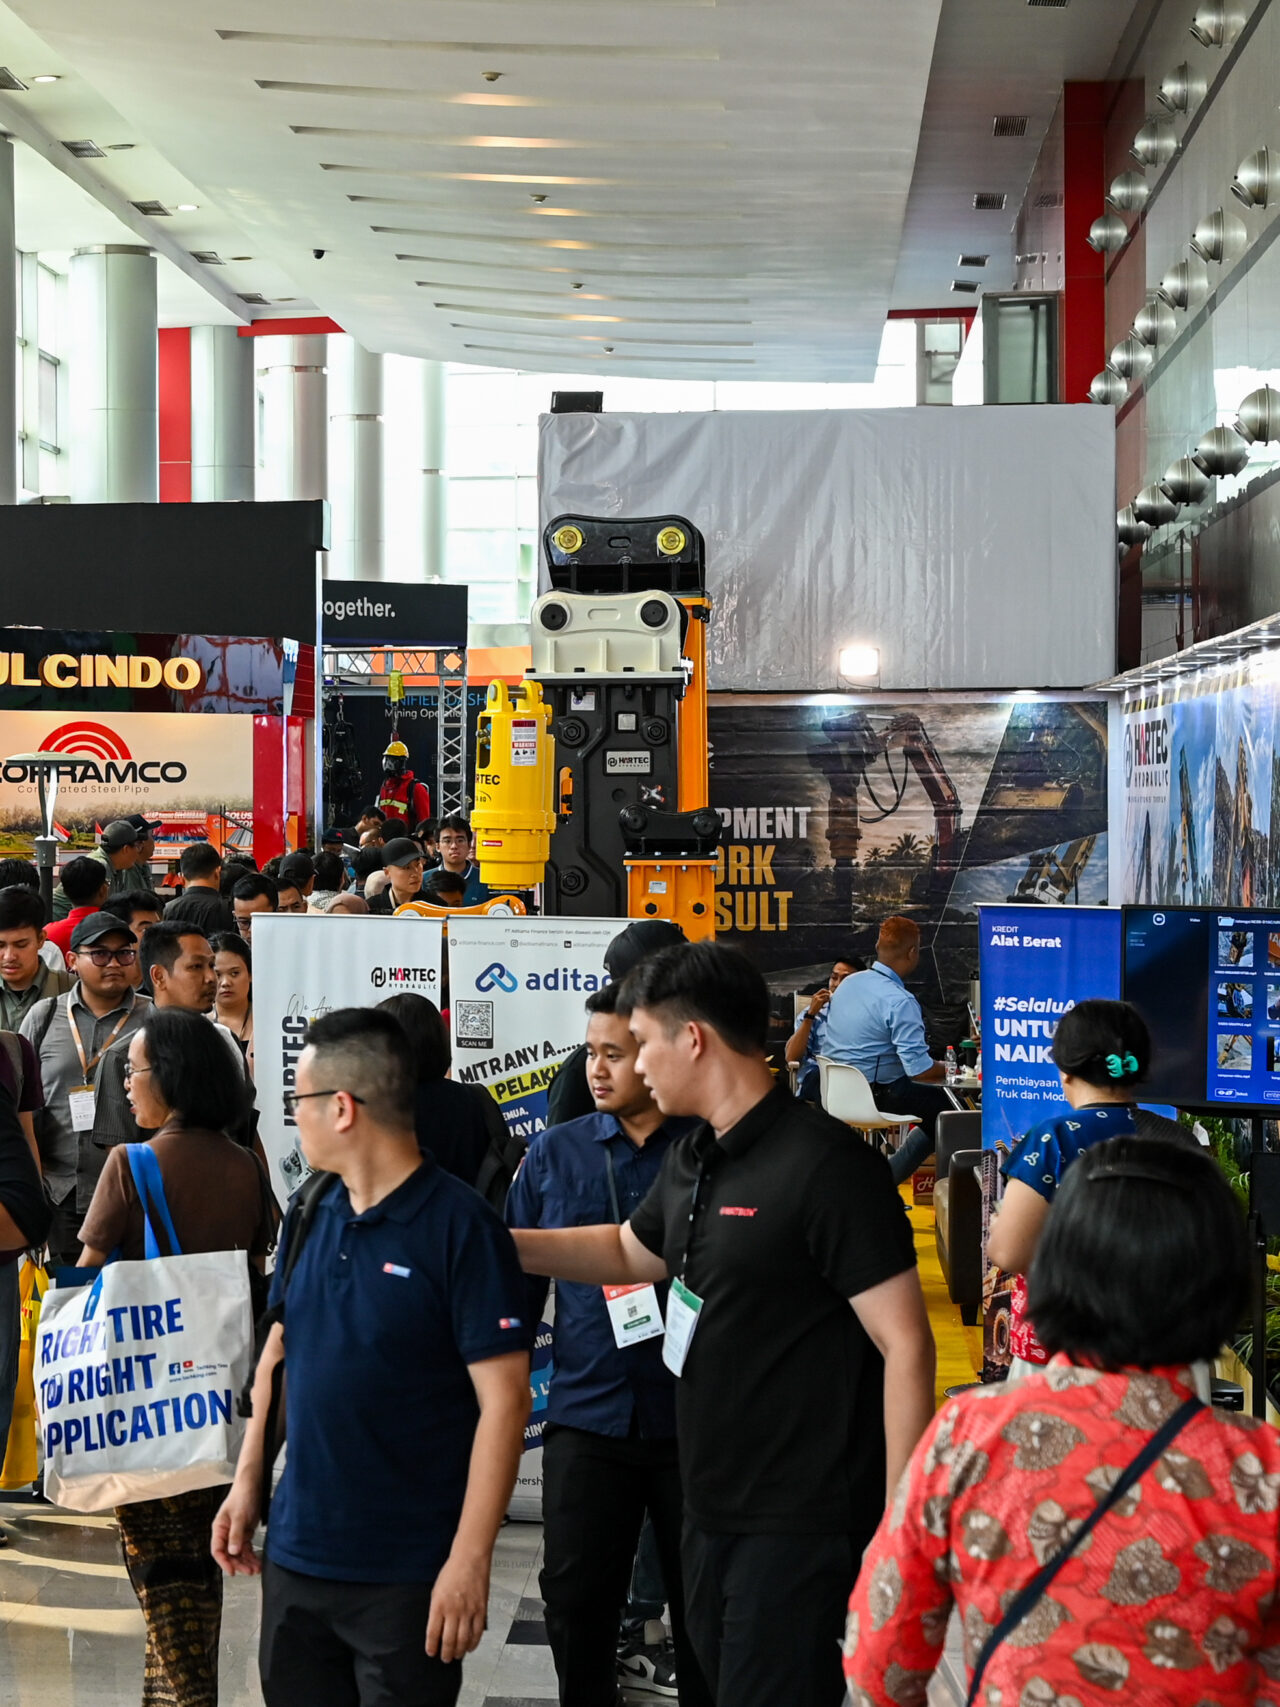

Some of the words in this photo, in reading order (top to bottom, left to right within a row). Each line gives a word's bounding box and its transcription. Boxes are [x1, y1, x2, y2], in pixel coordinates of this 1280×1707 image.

[1134, 718, 1168, 766] HARTEC
[17, 785, 88, 796] Coruated
[91, 785, 121, 793] Steel
[124, 785, 150, 795] Pipe
[225, 811, 254, 820] SOLUS
[992, 925, 1019, 933] KREDIT
[991, 935, 1020, 947] Alat
[1022, 936, 1062, 948] Berat
[389, 967, 436, 982] HARTEC
[995, 1043, 1055, 1063] NAIK
[996, 1075, 1059, 1089] Pembiayaan
[996, 1089, 1019, 1099] Truk
[1021, 1089, 1040, 1100] dan
[1043, 1091, 1067, 1101] Mod
[107, 1298, 184, 1343] TIRE
[41, 1320, 106, 1368] RIGH
[68, 1353, 157, 1404] RIGHT
[44, 1389, 232, 1459] PPLICATION
